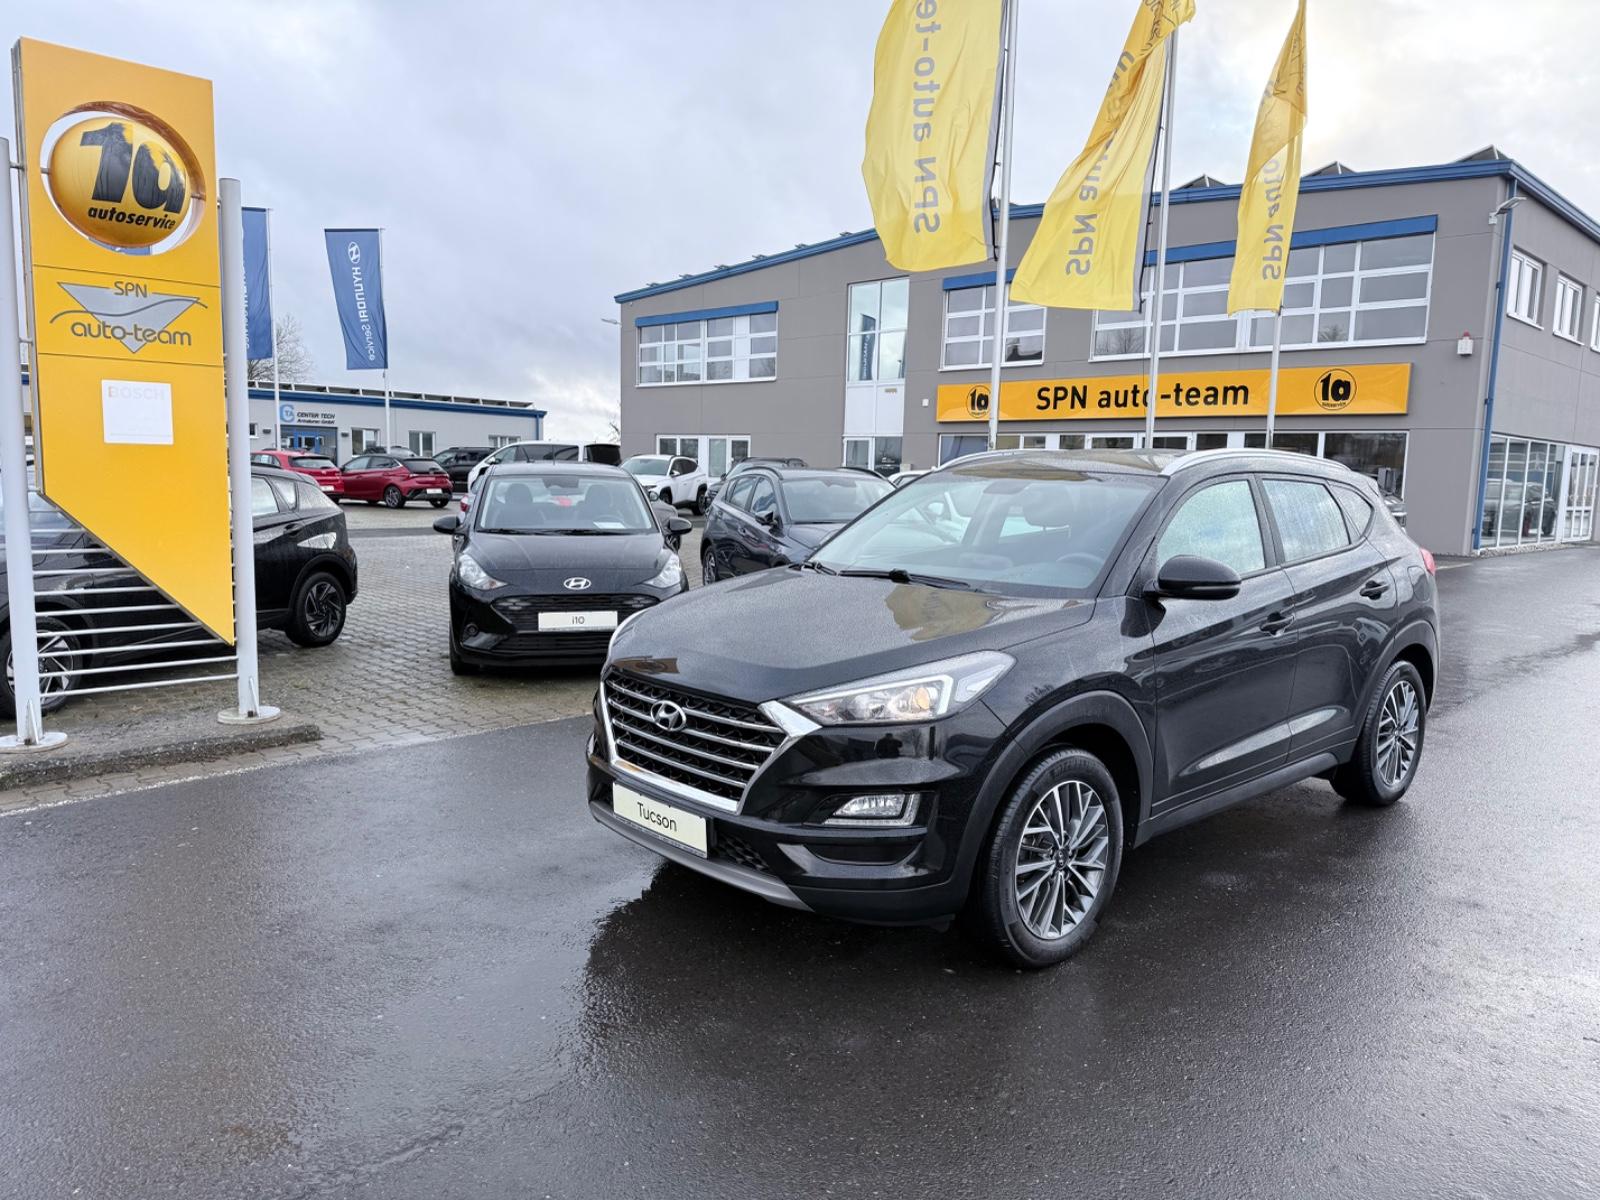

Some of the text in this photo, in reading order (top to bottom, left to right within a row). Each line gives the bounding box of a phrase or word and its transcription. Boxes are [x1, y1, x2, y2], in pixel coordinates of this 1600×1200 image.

[80, 122, 186, 215] 1a
[87, 206, 176, 232] autoservice
[114, 280, 148, 298] SPN
[70, 319, 192, 346] auto-team
[108, 385, 165, 401] BOSCH
[969, 388, 989, 411] 1a
[1036, 385, 1088, 411] SPN
[1320, 373, 1351, 402] 1a
[571, 614, 586, 625] i10
[636, 801, 678, 832] Tucson
